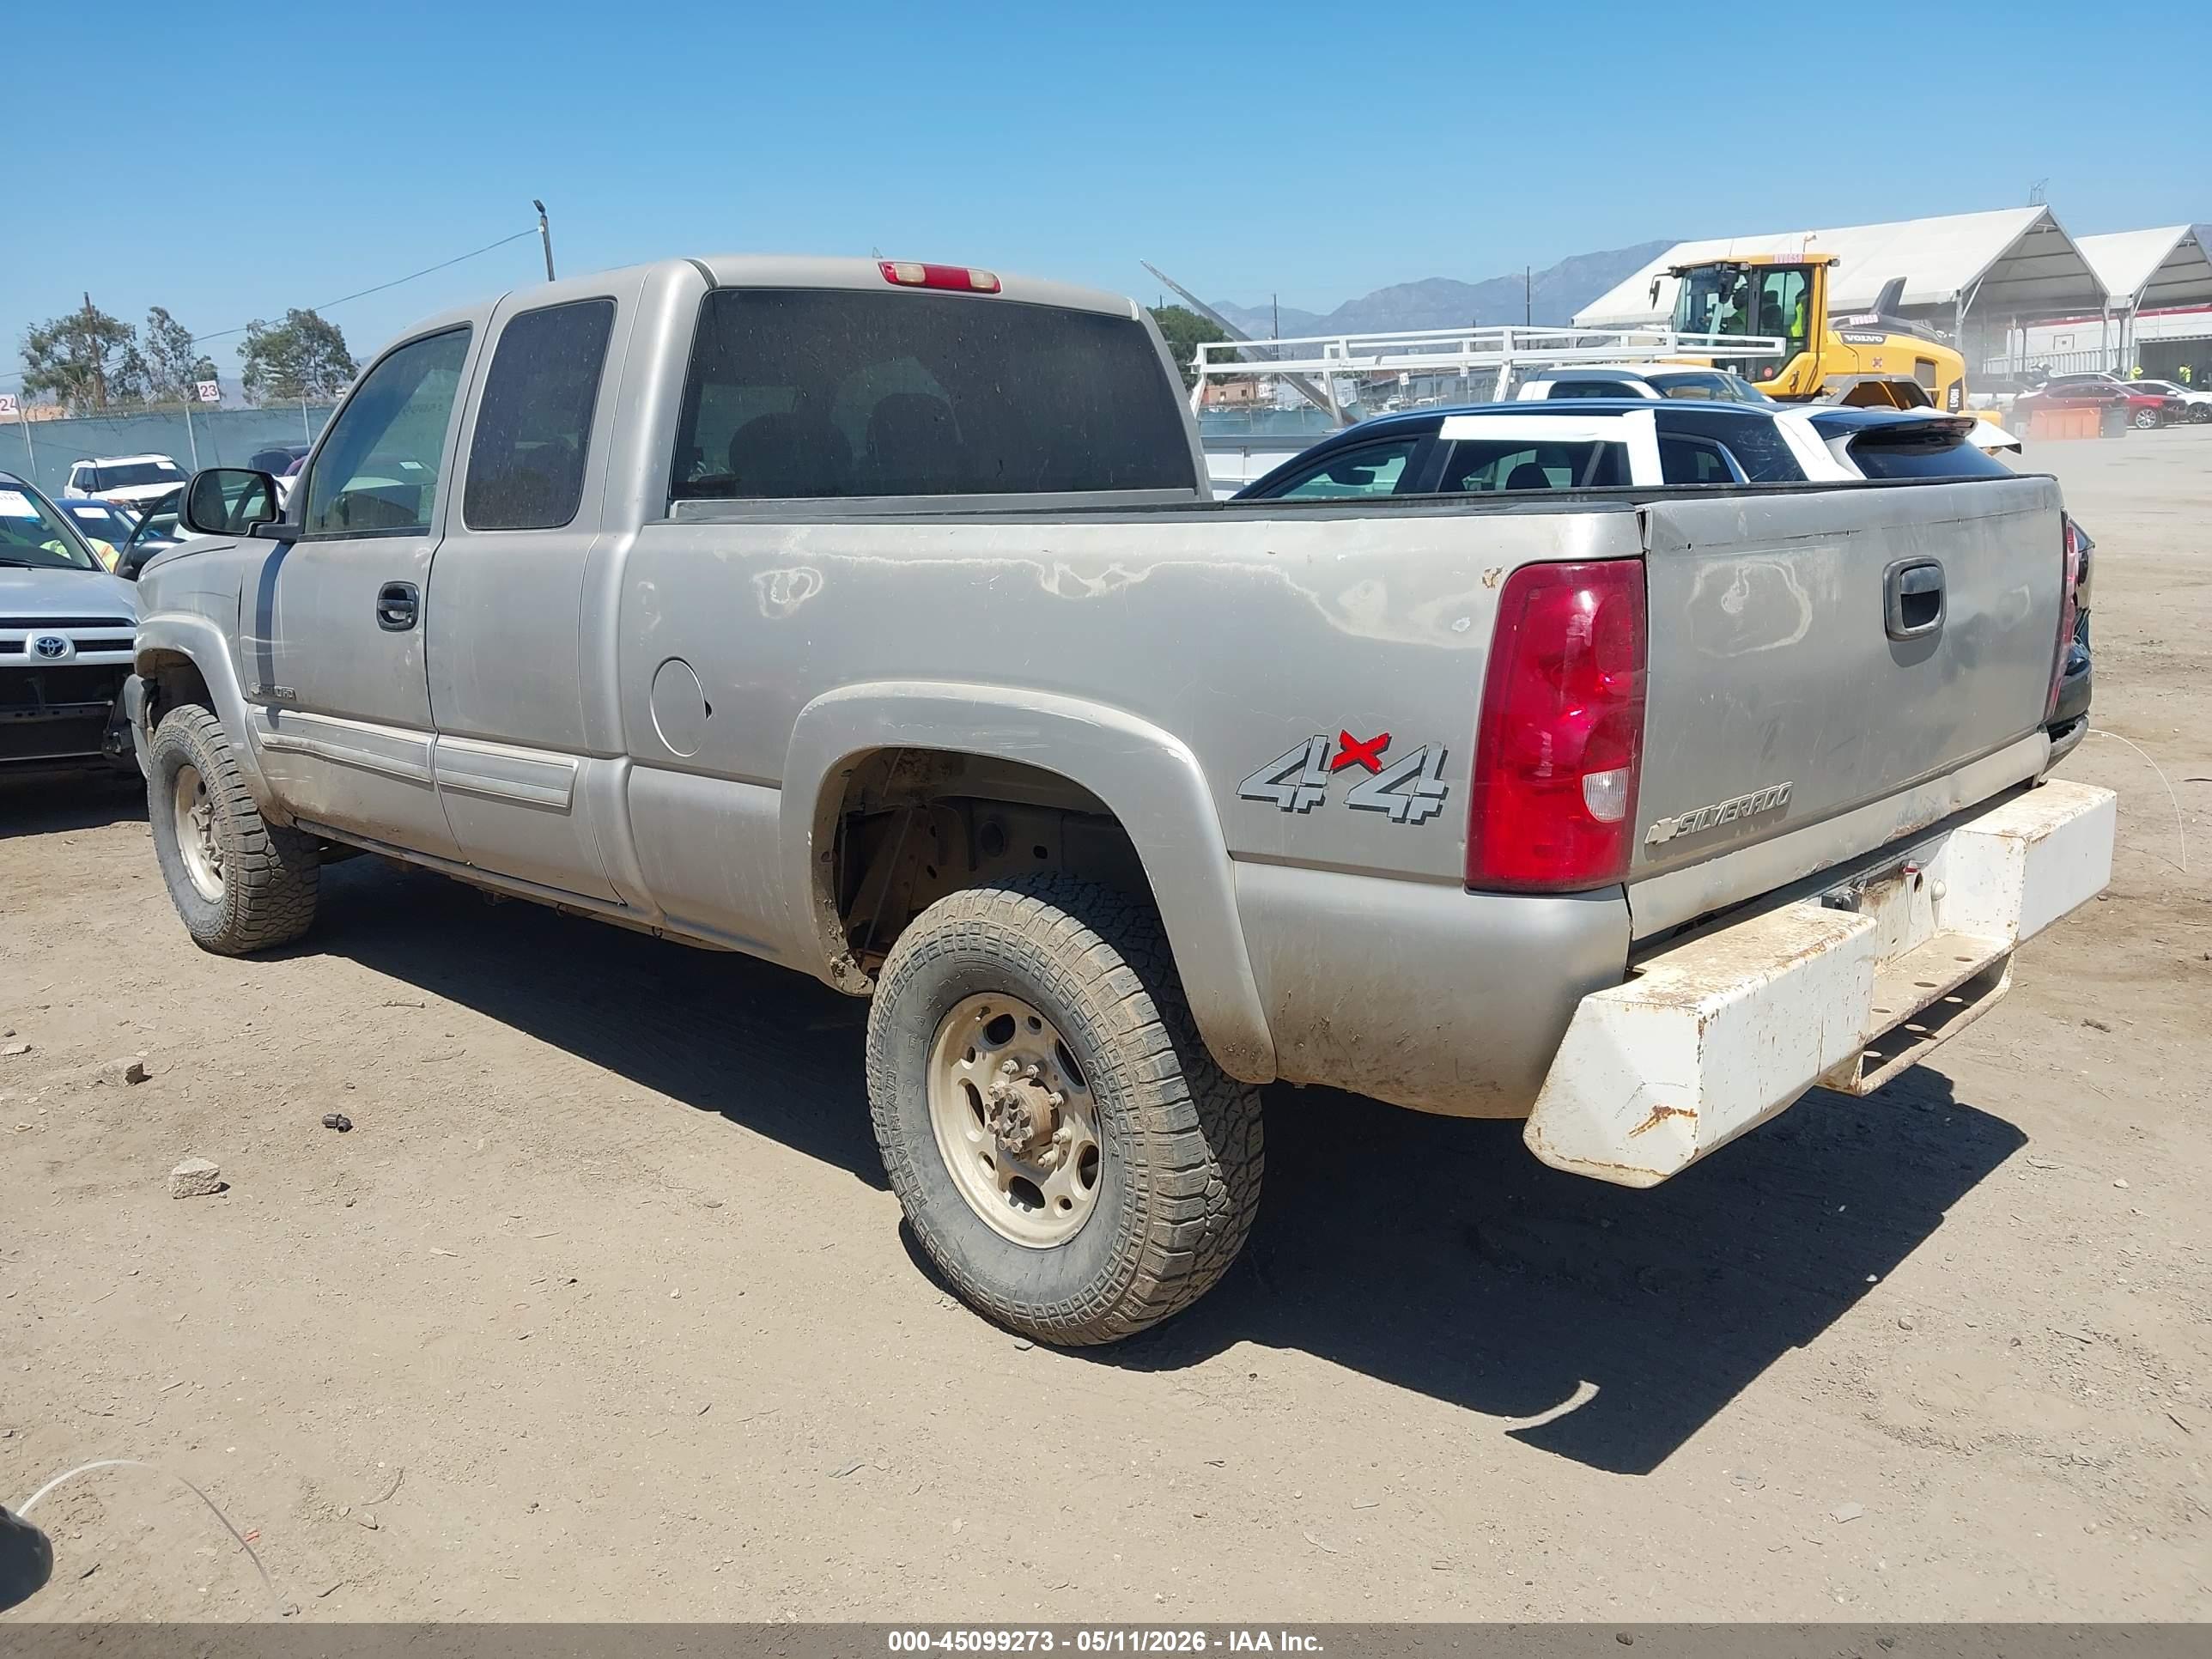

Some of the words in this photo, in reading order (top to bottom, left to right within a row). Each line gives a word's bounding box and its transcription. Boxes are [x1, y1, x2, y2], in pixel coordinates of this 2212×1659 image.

[200, 385, 218, 398] 23
[1949, 388, 1960, 408] L90H
[1676, 781, 1794, 838] SILVERADO
